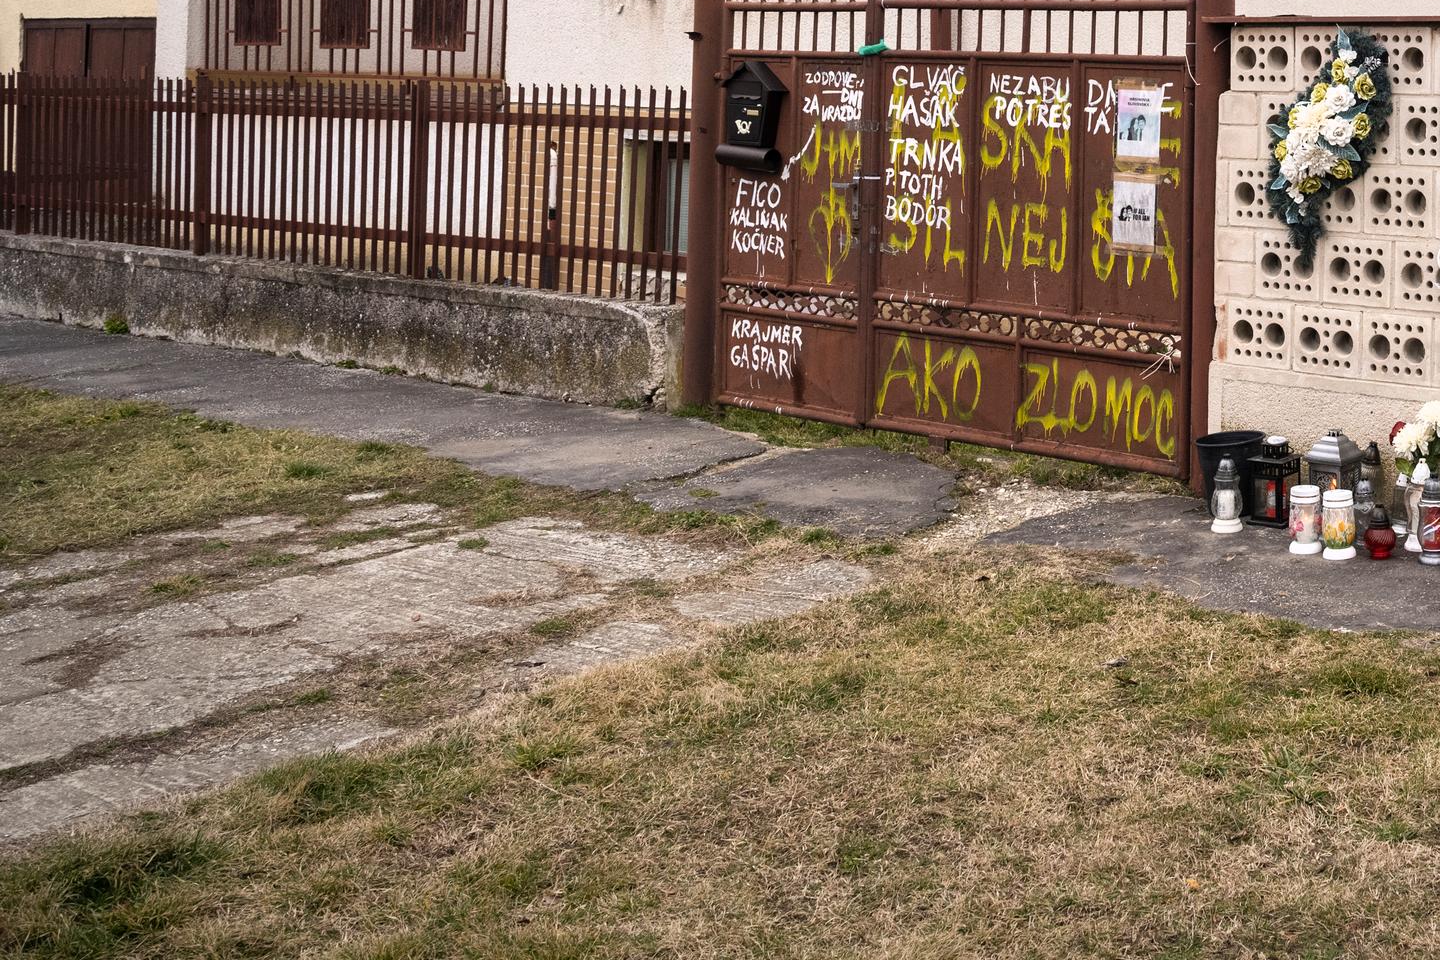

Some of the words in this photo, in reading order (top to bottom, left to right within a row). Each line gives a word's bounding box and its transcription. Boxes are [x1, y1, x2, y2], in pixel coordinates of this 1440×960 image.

[803, 94, 819, 116] ZA
[889, 137, 962, 175] TRNKA
[736, 178, 781, 208] FICO
[884, 192, 951, 230] BÖDÖR
[731, 227, 785, 260] KOČNER
[731, 318, 803, 351] KRAJMER
[875, 331, 981, 421] AKO
